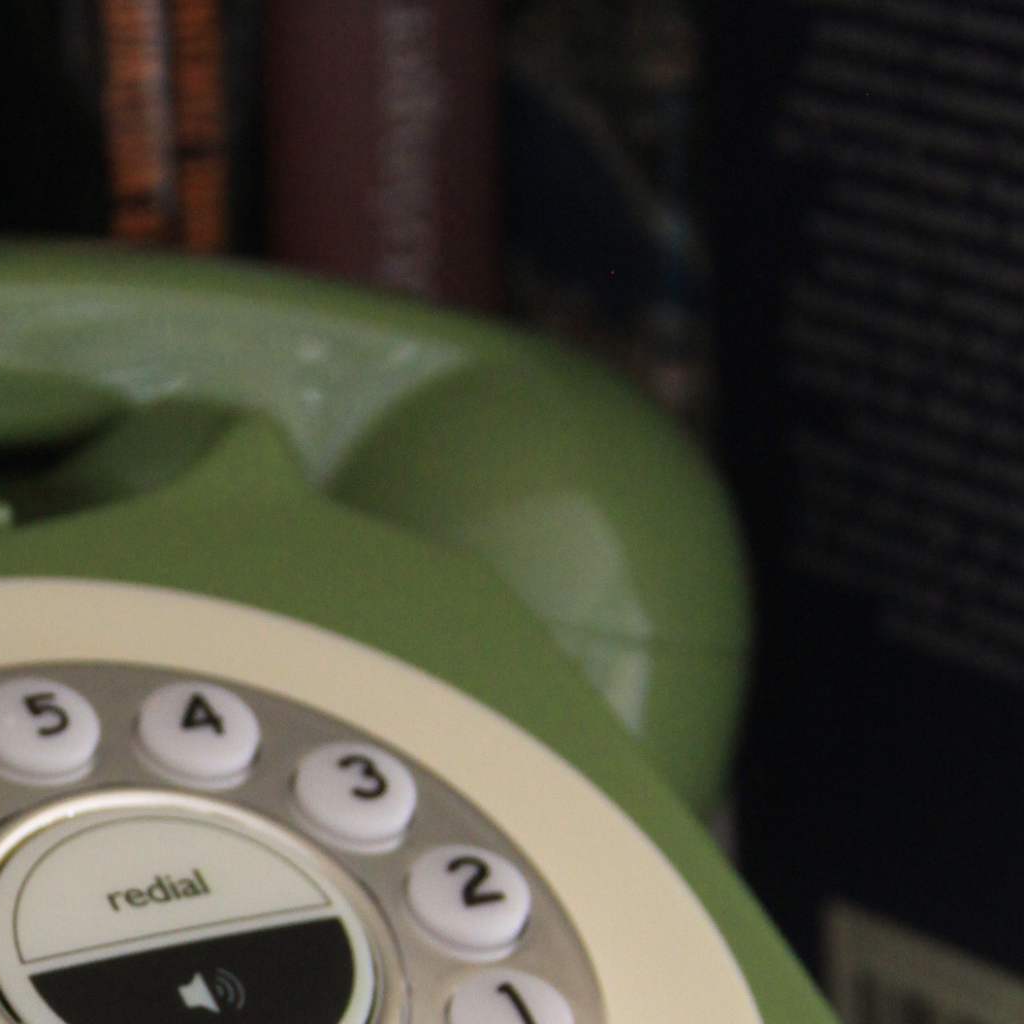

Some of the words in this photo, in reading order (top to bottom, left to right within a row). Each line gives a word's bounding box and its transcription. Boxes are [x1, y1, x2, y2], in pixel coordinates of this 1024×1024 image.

[23, 692, 69, 738] 5
[180, 691, 224, 736] 4
[337, 753, 388, 801] 3
[107, 867, 211, 913] redial
[446, 855, 505, 908] 2
